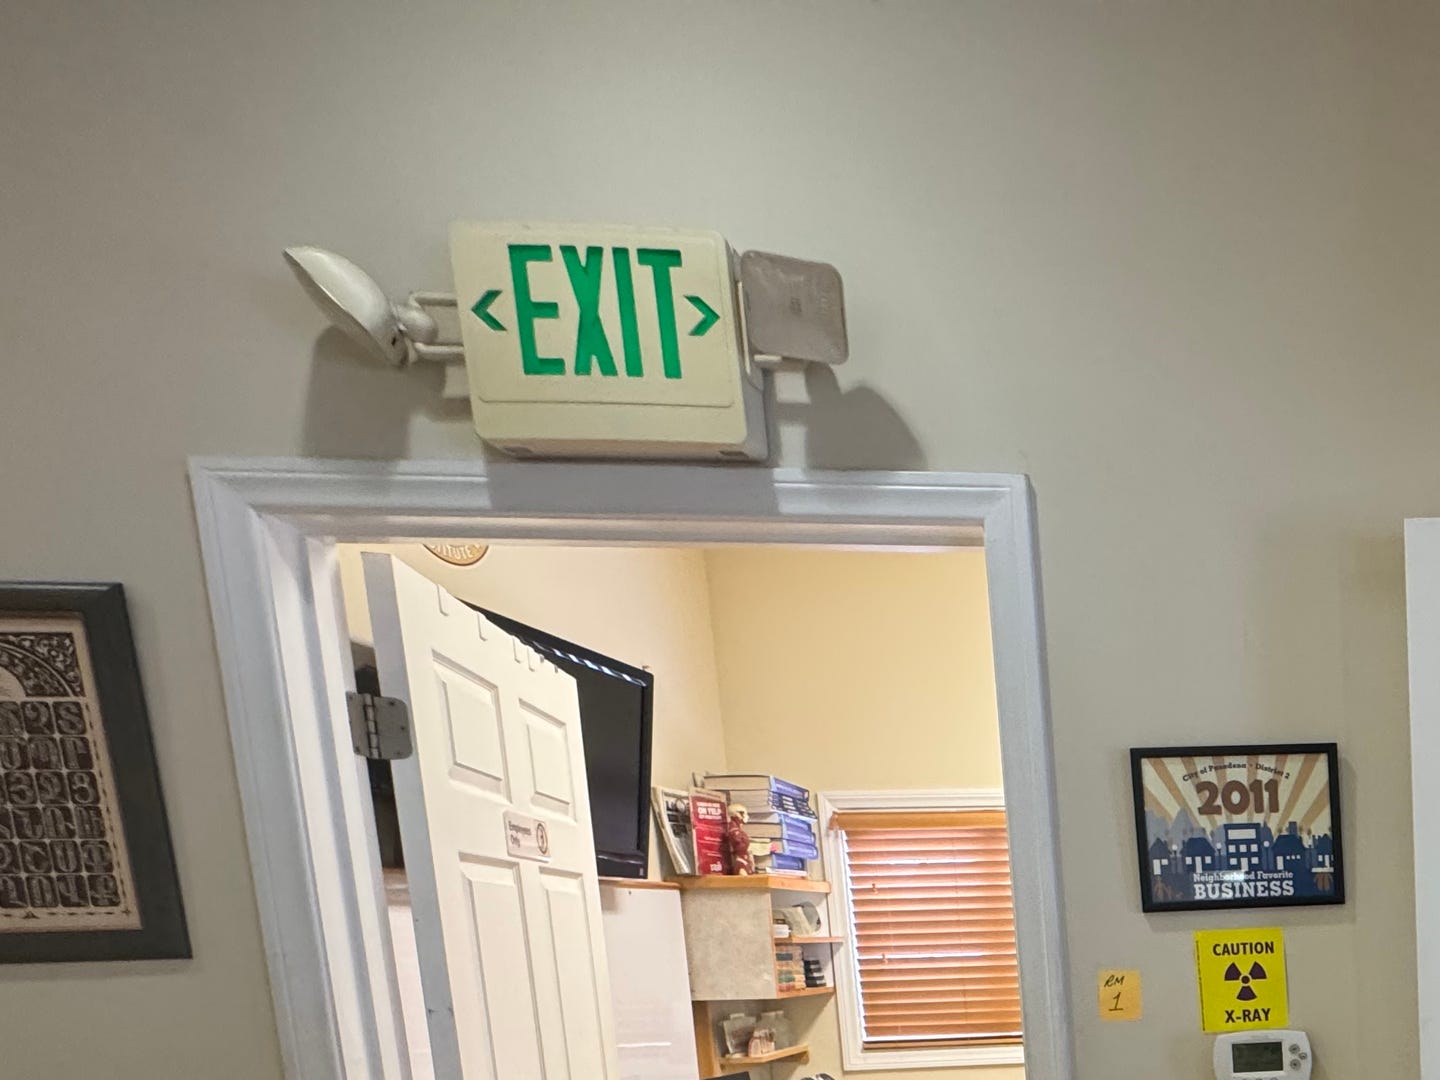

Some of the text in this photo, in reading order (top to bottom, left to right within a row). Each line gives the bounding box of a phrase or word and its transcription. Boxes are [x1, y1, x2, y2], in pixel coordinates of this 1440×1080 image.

[507, 243, 682, 379] EXIT
[1255, 763, 1284, 777] District
[1195, 778, 1279, 815] 2011
[1257, 871, 1294, 879] Favorite
[1194, 880, 1294, 900] BUSINESS
[1212, 941, 1275, 956] CAUTION
[1108, 991, 1124, 1012] 1
[1225, 1007, 1271, 1024] X-RAY
